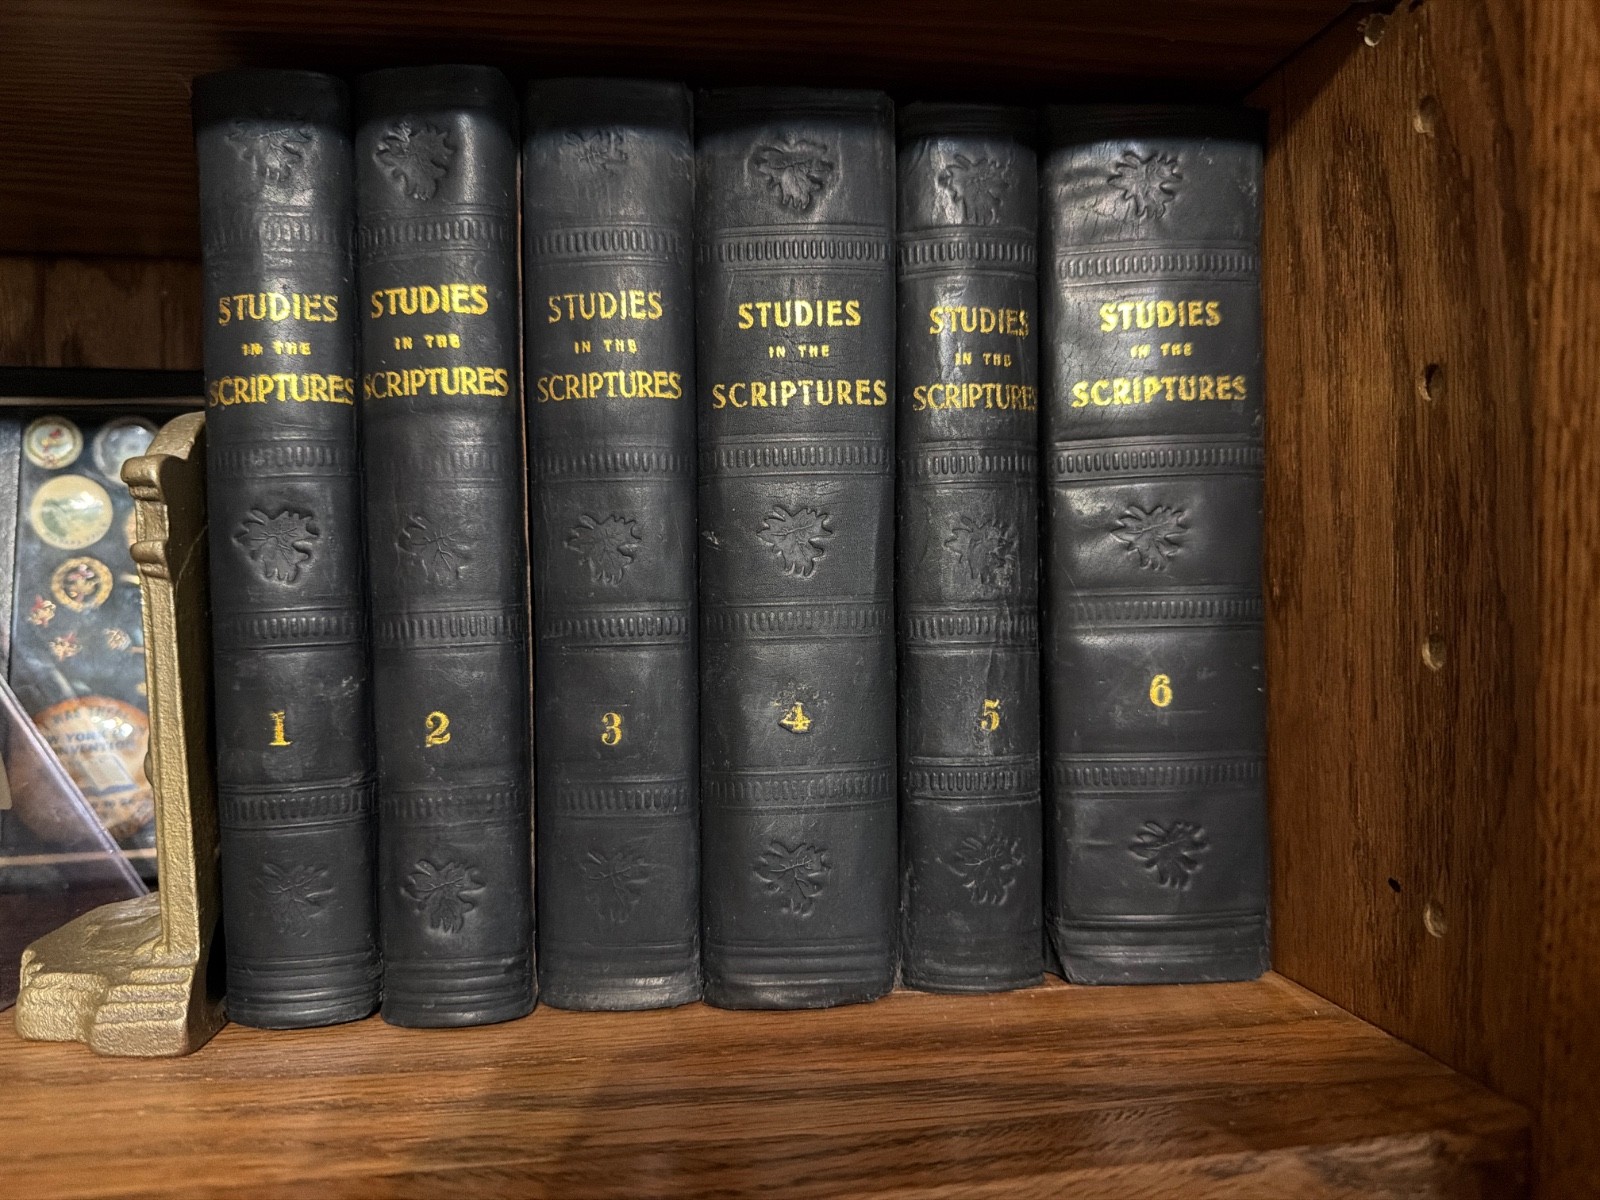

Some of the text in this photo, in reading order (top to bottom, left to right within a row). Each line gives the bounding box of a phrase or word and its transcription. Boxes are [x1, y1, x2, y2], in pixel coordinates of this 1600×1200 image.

[218, 292, 338, 326] STUDIES
[371, 284, 489, 319] STUDIES
[548, 290, 663, 324] STUDIES
[738, 300, 862, 329] STUDIES
[1099, 300, 1222, 333] STUDIES
[929, 305, 1029, 339] STUDIES
[242, 340, 312, 356] IN THE
[394, 334, 461, 350] IN THE
[574, 339, 638, 354] IN THE
[769, 344, 830, 358] IN THE
[1130, 342, 1193, 359] IN THE
[955, 352, 1012, 367] IN THE
[209, 373, 353, 407] SCRIPTURES
[363, 366, 509, 400] SCRIPTURES
[537, 370, 682, 403] SCRIPTURES
[712, 379, 888, 409] SCRIPTURES
[1071, 375, 1248, 408] SCRIPTURES
[1149, 673, 1173, 708] 6
[269, 711, 290, 747] 1
[425, 711, 452, 747] 2
[601, 712, 623, 746] 3
[780, 701, 812, 733] 4
[981, 699, 1000, 731] 5
